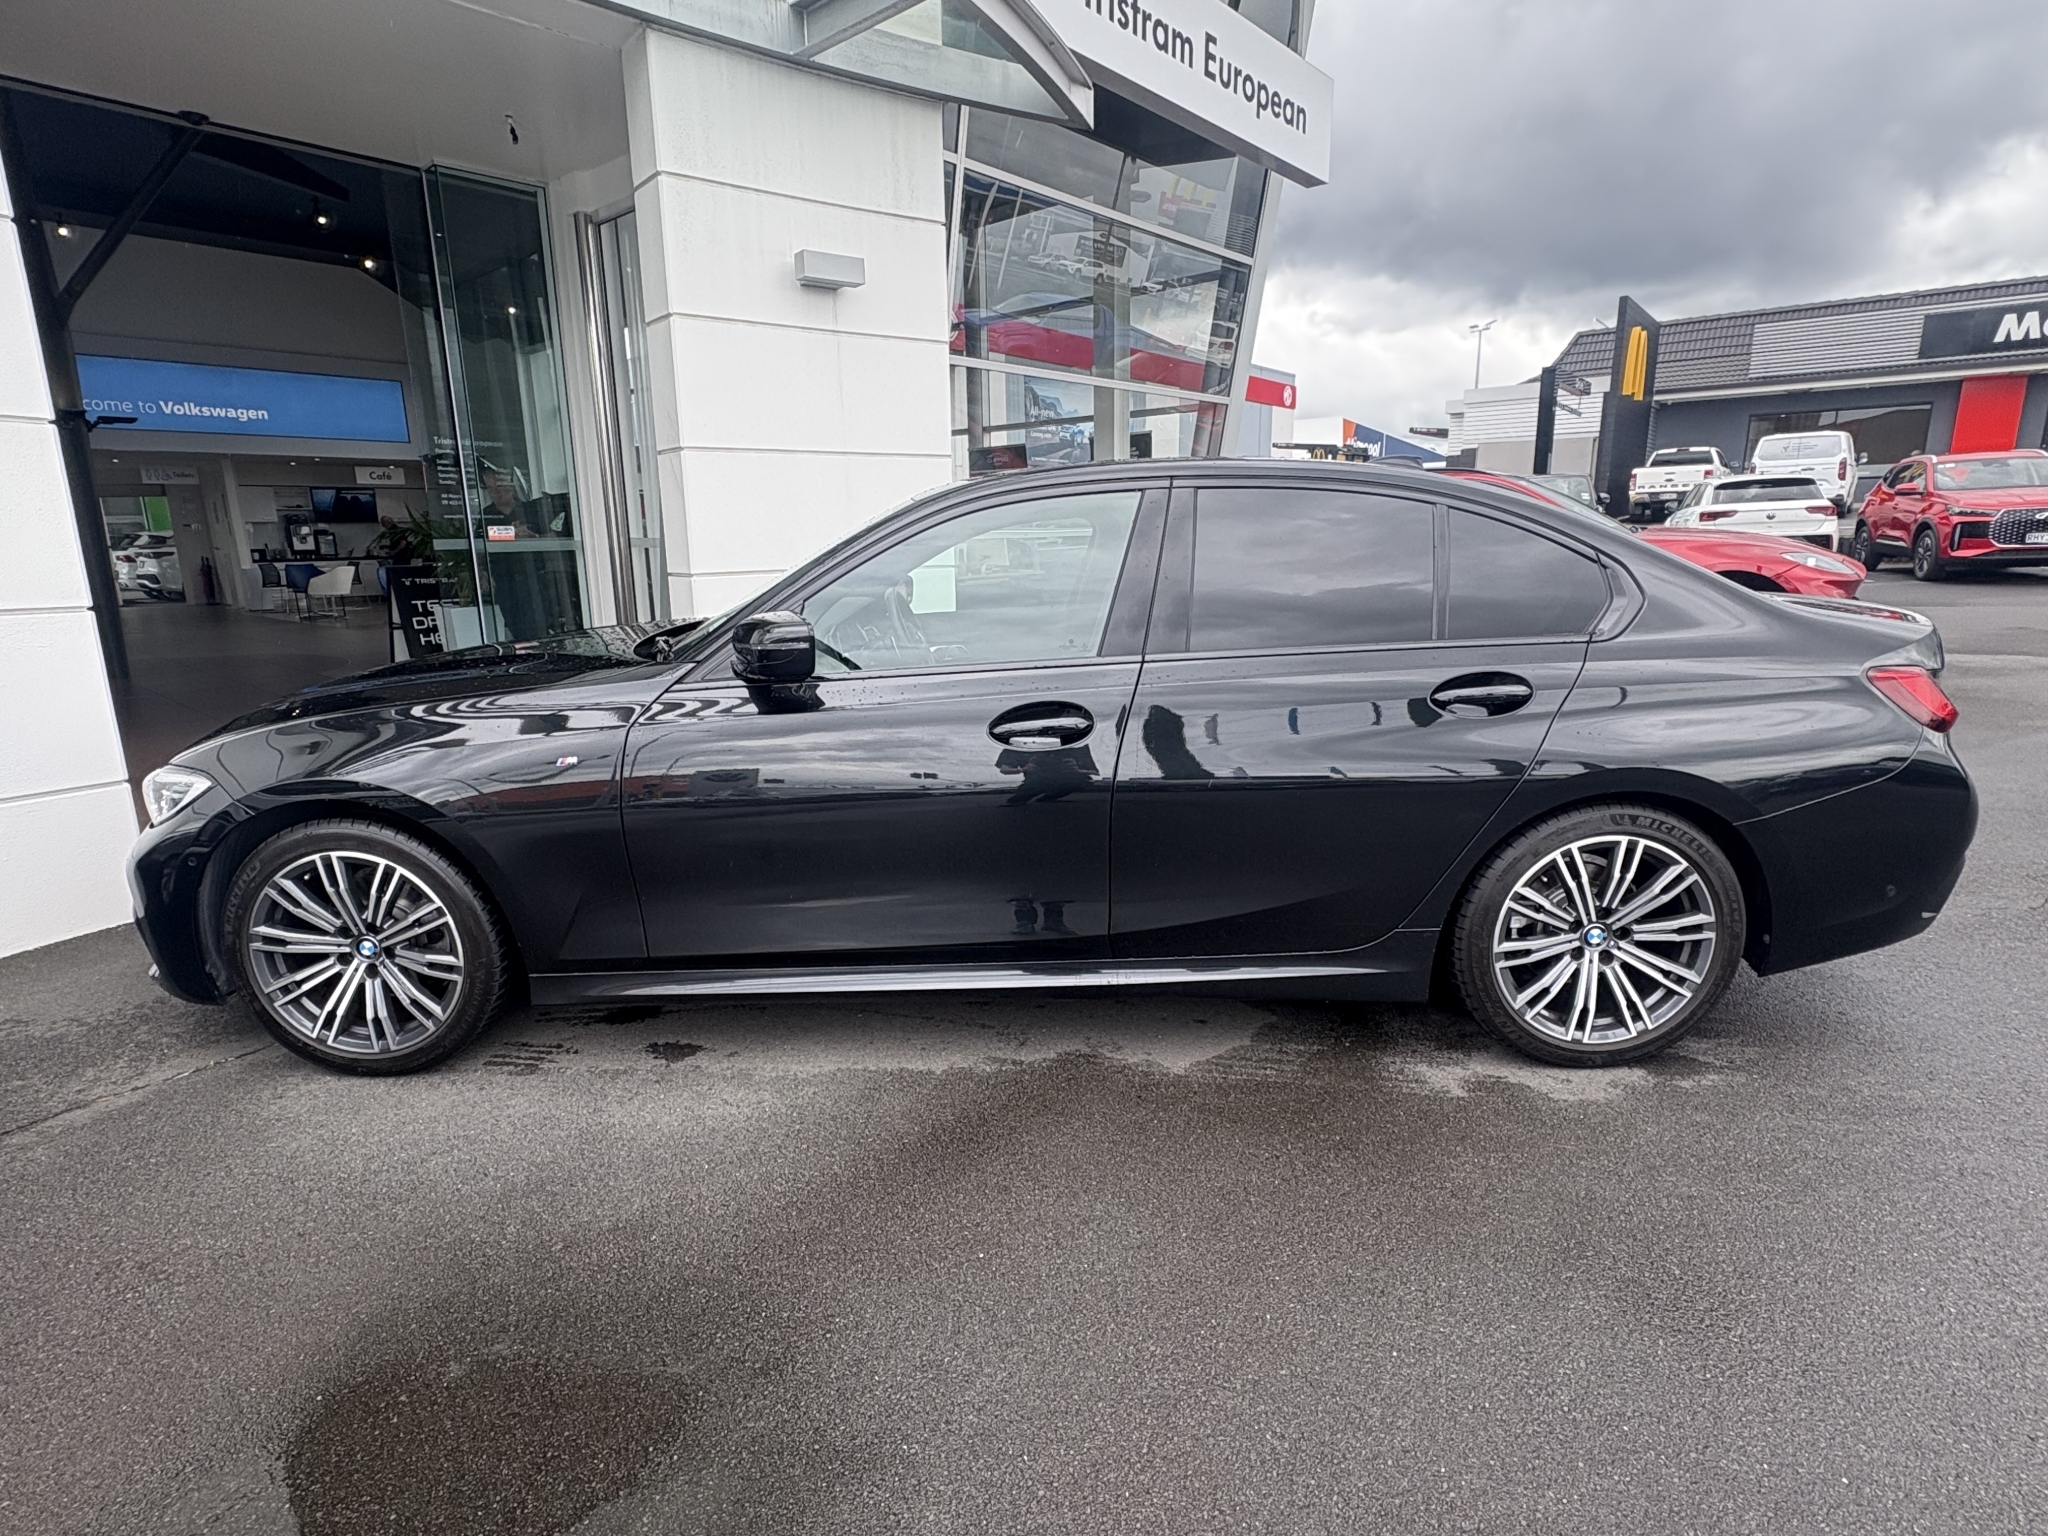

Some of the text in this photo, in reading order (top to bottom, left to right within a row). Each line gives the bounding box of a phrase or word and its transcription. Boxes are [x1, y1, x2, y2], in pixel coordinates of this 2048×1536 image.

[1203, 31, 1307, 135] European
[1993, 310, 2048, 343] M
[138, 401, 156, 414] to
[158, 401, 269, 422] Volkswagen
[368, 470, 393, 482] Café
